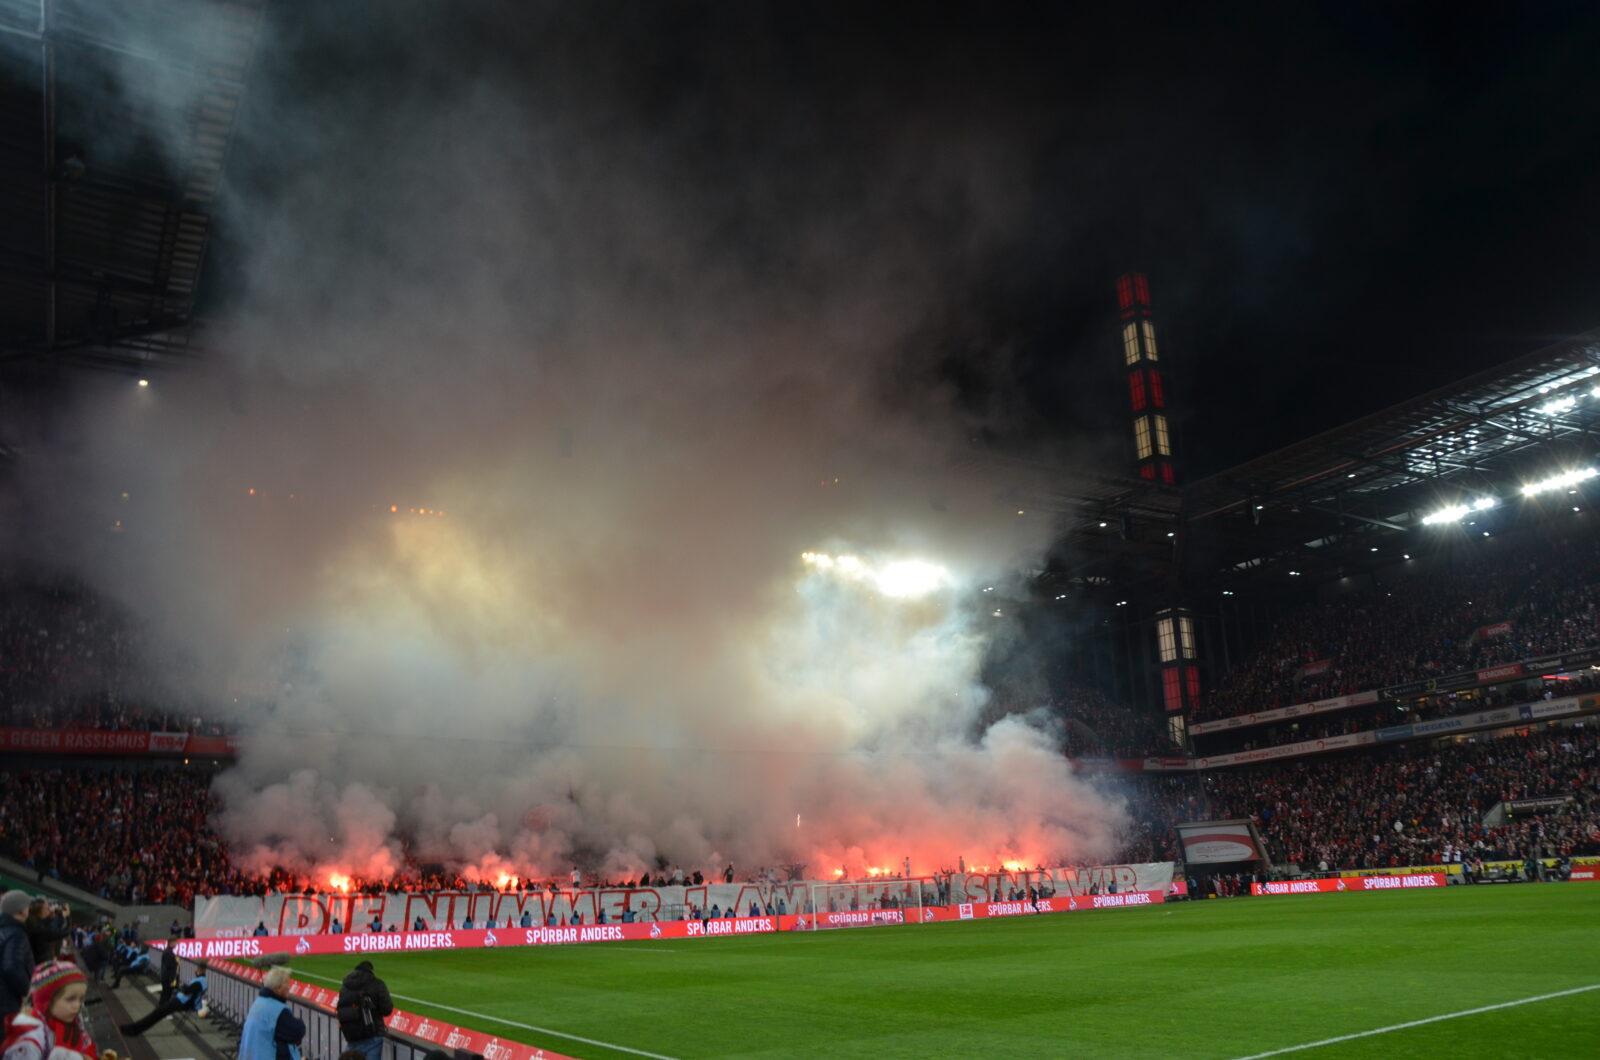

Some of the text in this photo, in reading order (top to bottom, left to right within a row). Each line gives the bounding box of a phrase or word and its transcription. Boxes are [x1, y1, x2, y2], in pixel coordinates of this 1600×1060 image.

[10, 731, 60, 747] GEGEN
[64, 732, 146, 749] RASSISMUS
[1290, 881, 1321, 894] ANDERS.
[1364, 875, 1438, 889] SPÜRBAR ANDERS.
[277, 896, 384, 936] DIE
[403, 889, 661, 931] NUMMER
[733, 883, 809, 917] AM
[963, 871, 1053, 904] SIND
[1064, 865, 1137, 897] WIR
[1093, 893, 1152, 907] SPÜRBAR ANDERS.
[988, 902, 1022, 916] SPÜRBAR
[735, 918, 774, 933] ANDERS.
[344, 932, 455, 951] SPÜRBAR ANDERS.
[526, 926, 624, 944] SPÜRBAR ANDERS.
[205, 940, 263, 957] ANDERS.
